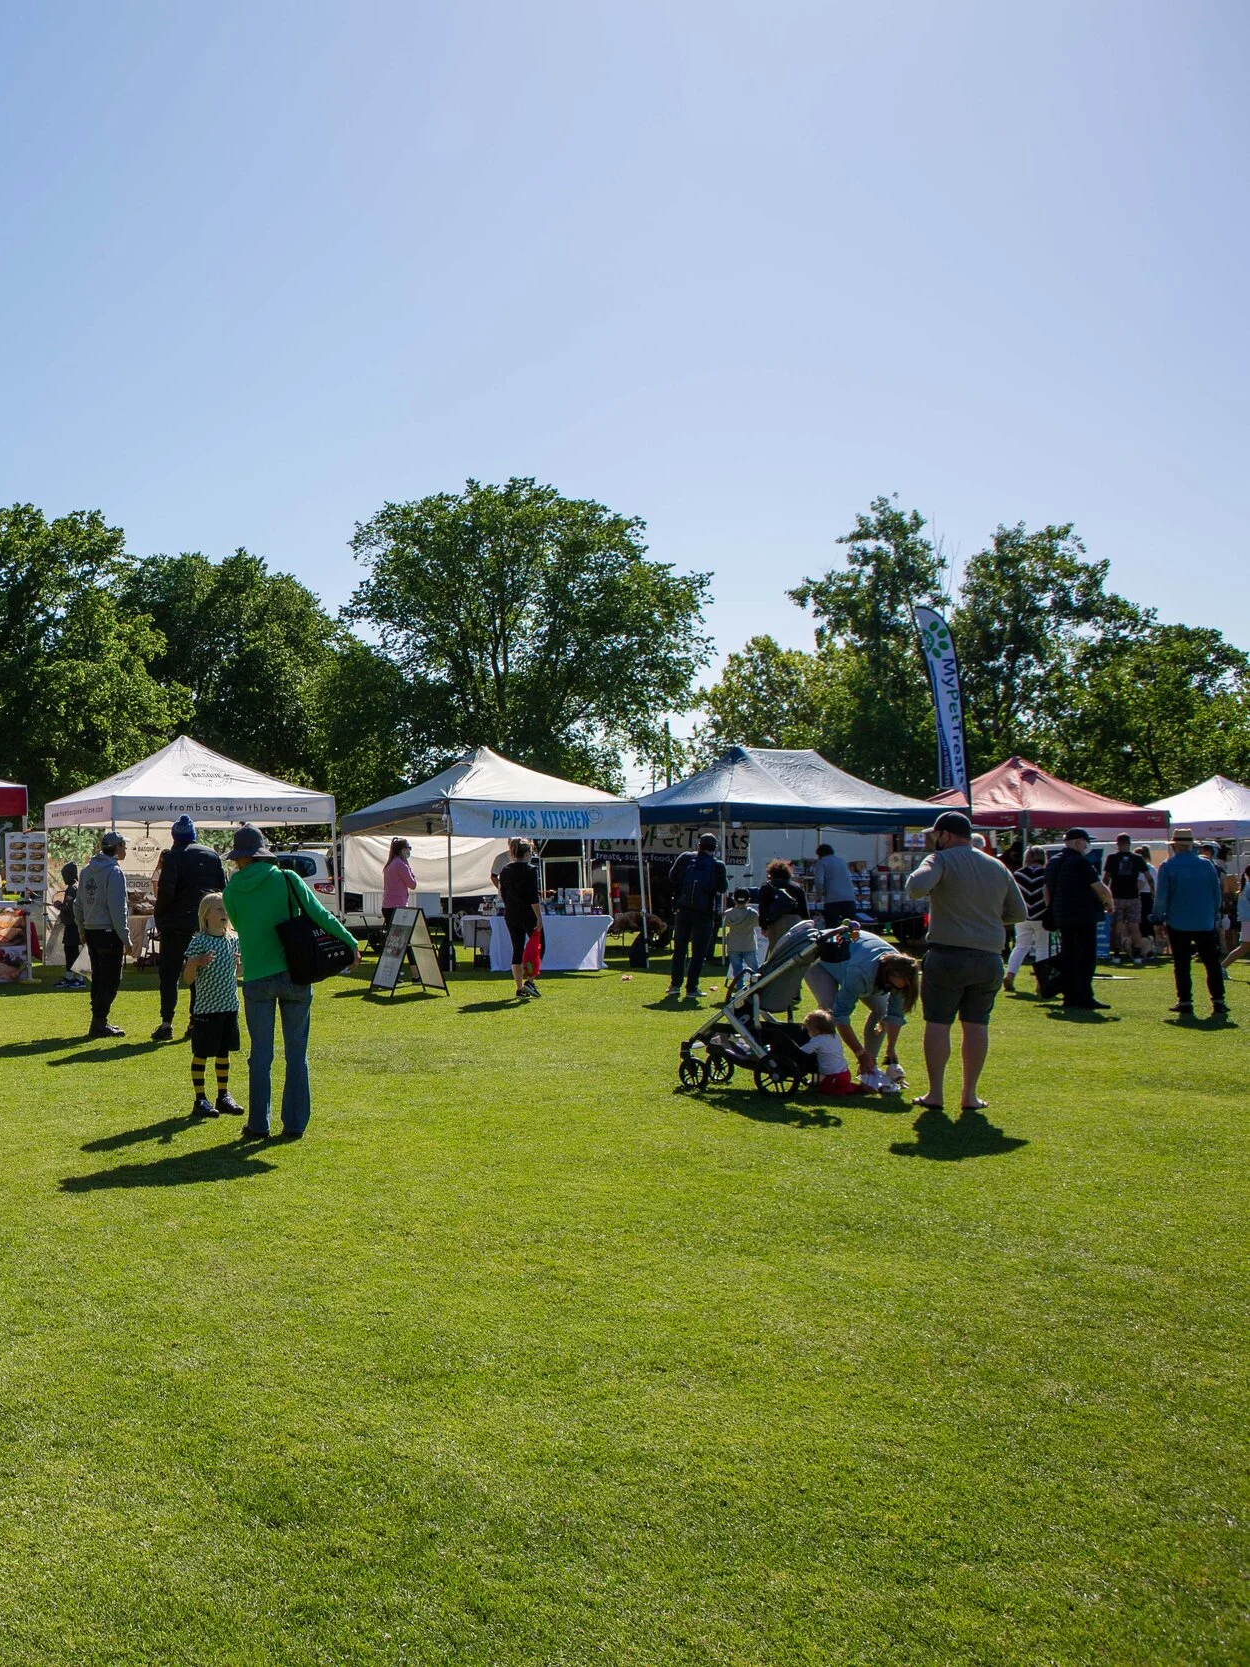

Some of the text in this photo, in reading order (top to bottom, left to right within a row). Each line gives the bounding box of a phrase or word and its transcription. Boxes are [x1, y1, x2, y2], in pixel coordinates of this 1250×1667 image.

[941, 658, 964, 785] MyPetTreats
[138, 803, 308, 814] www.frombasquewithlove.com
[491, 809, 590, 829] PIPPA'S KITCHEN
